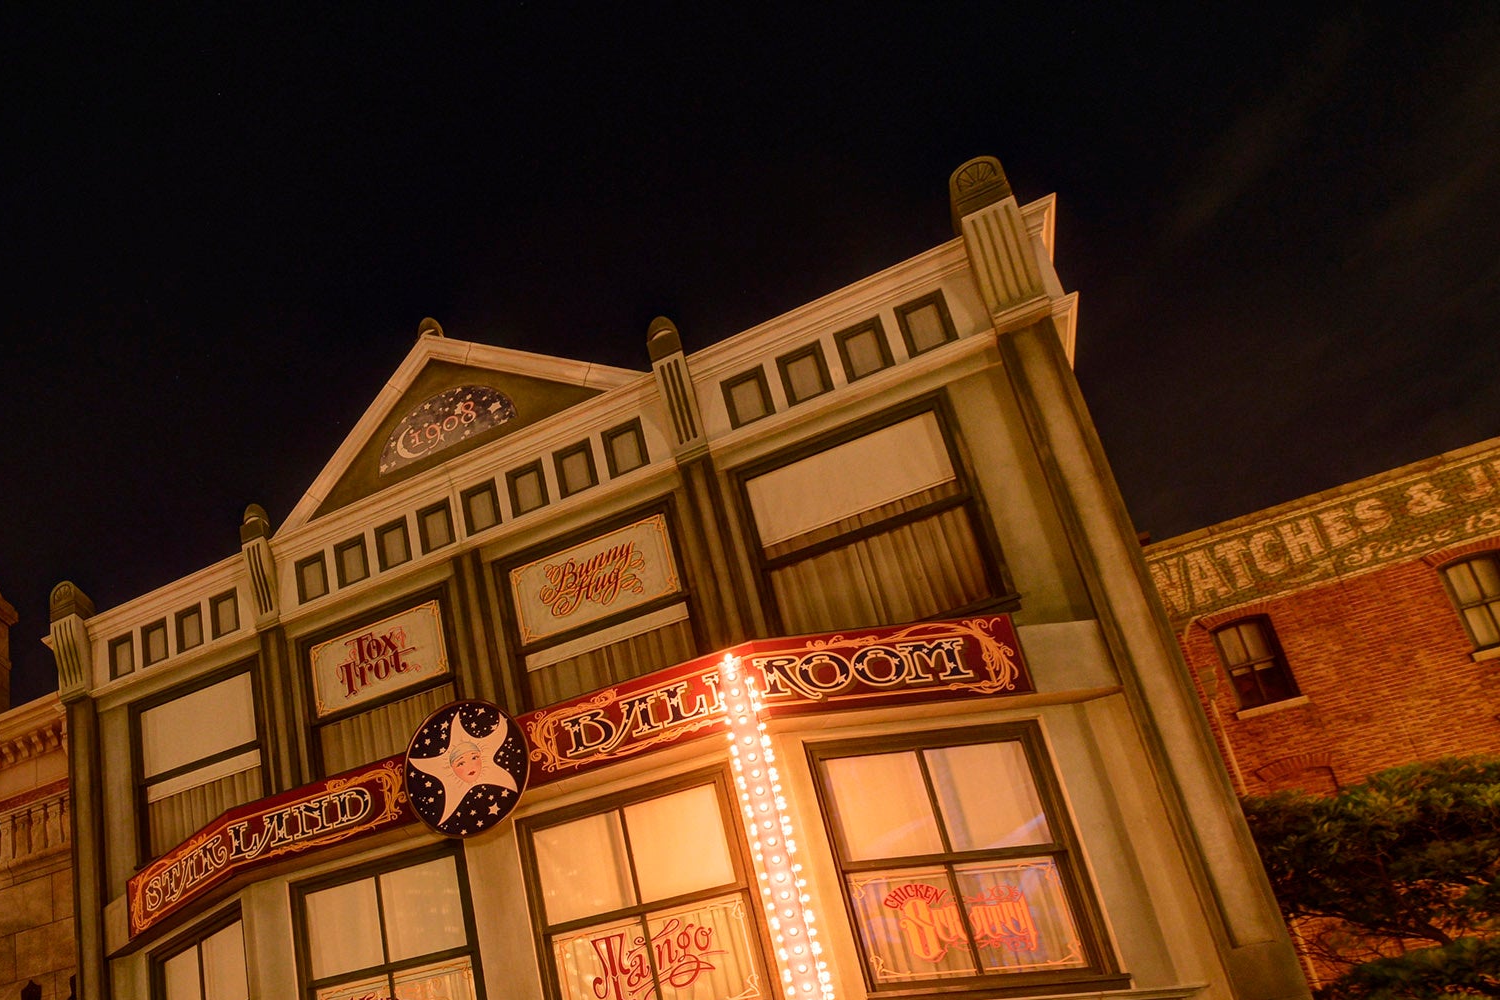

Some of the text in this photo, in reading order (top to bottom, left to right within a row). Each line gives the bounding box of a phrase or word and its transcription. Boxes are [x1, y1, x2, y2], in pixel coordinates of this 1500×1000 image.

[409, 401, 477, 448] 1908
[541, 541, 638, 603] Bunny
[1149, 498, 1393, 614] WATCHES
[1404, 482, 1449, 516] &
[553, 568, 625, 616] Hug
[340, 647, 415, 698] Trot
[145, 786, 372, 912] STARLAND
[883, 884, 947, 909] CHICKEN
